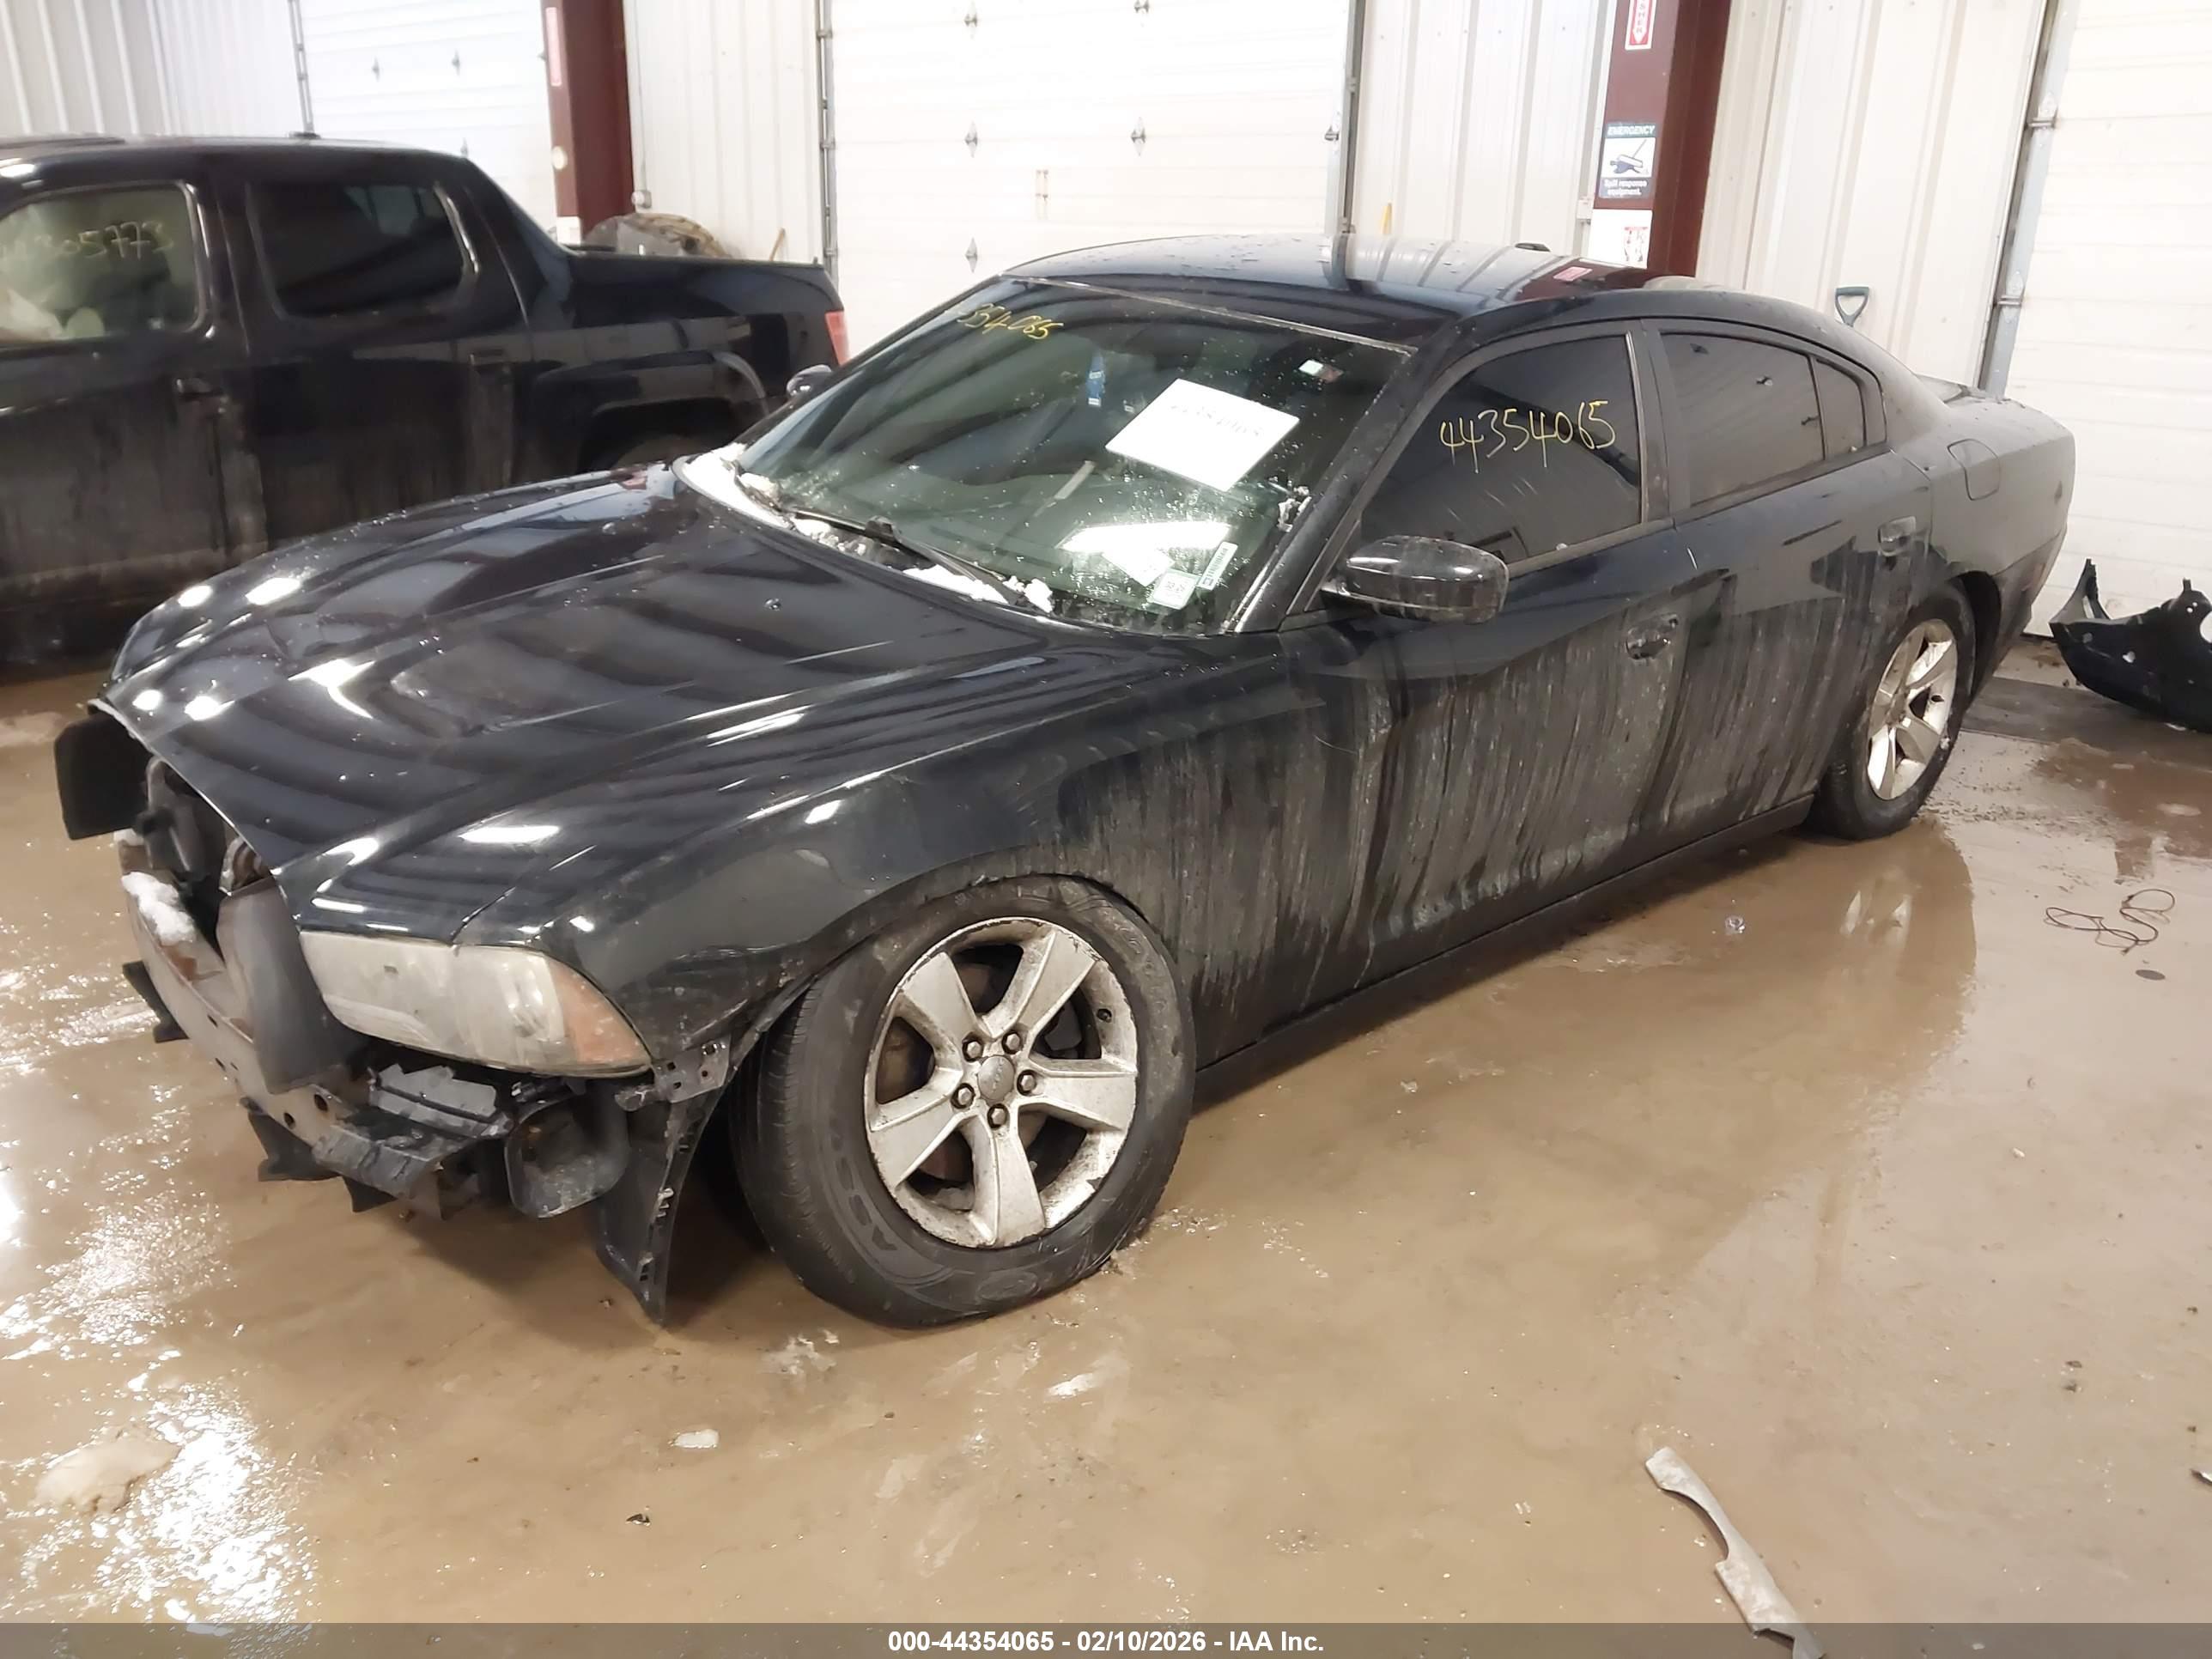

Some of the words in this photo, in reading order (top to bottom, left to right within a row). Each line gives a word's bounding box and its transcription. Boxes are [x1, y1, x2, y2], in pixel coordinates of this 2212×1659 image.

[1607, 125, 1656, 136] EMERGENCY
[1620, 179, 1648, 189] response
[1439, 400, 1616, 474] 44354065
